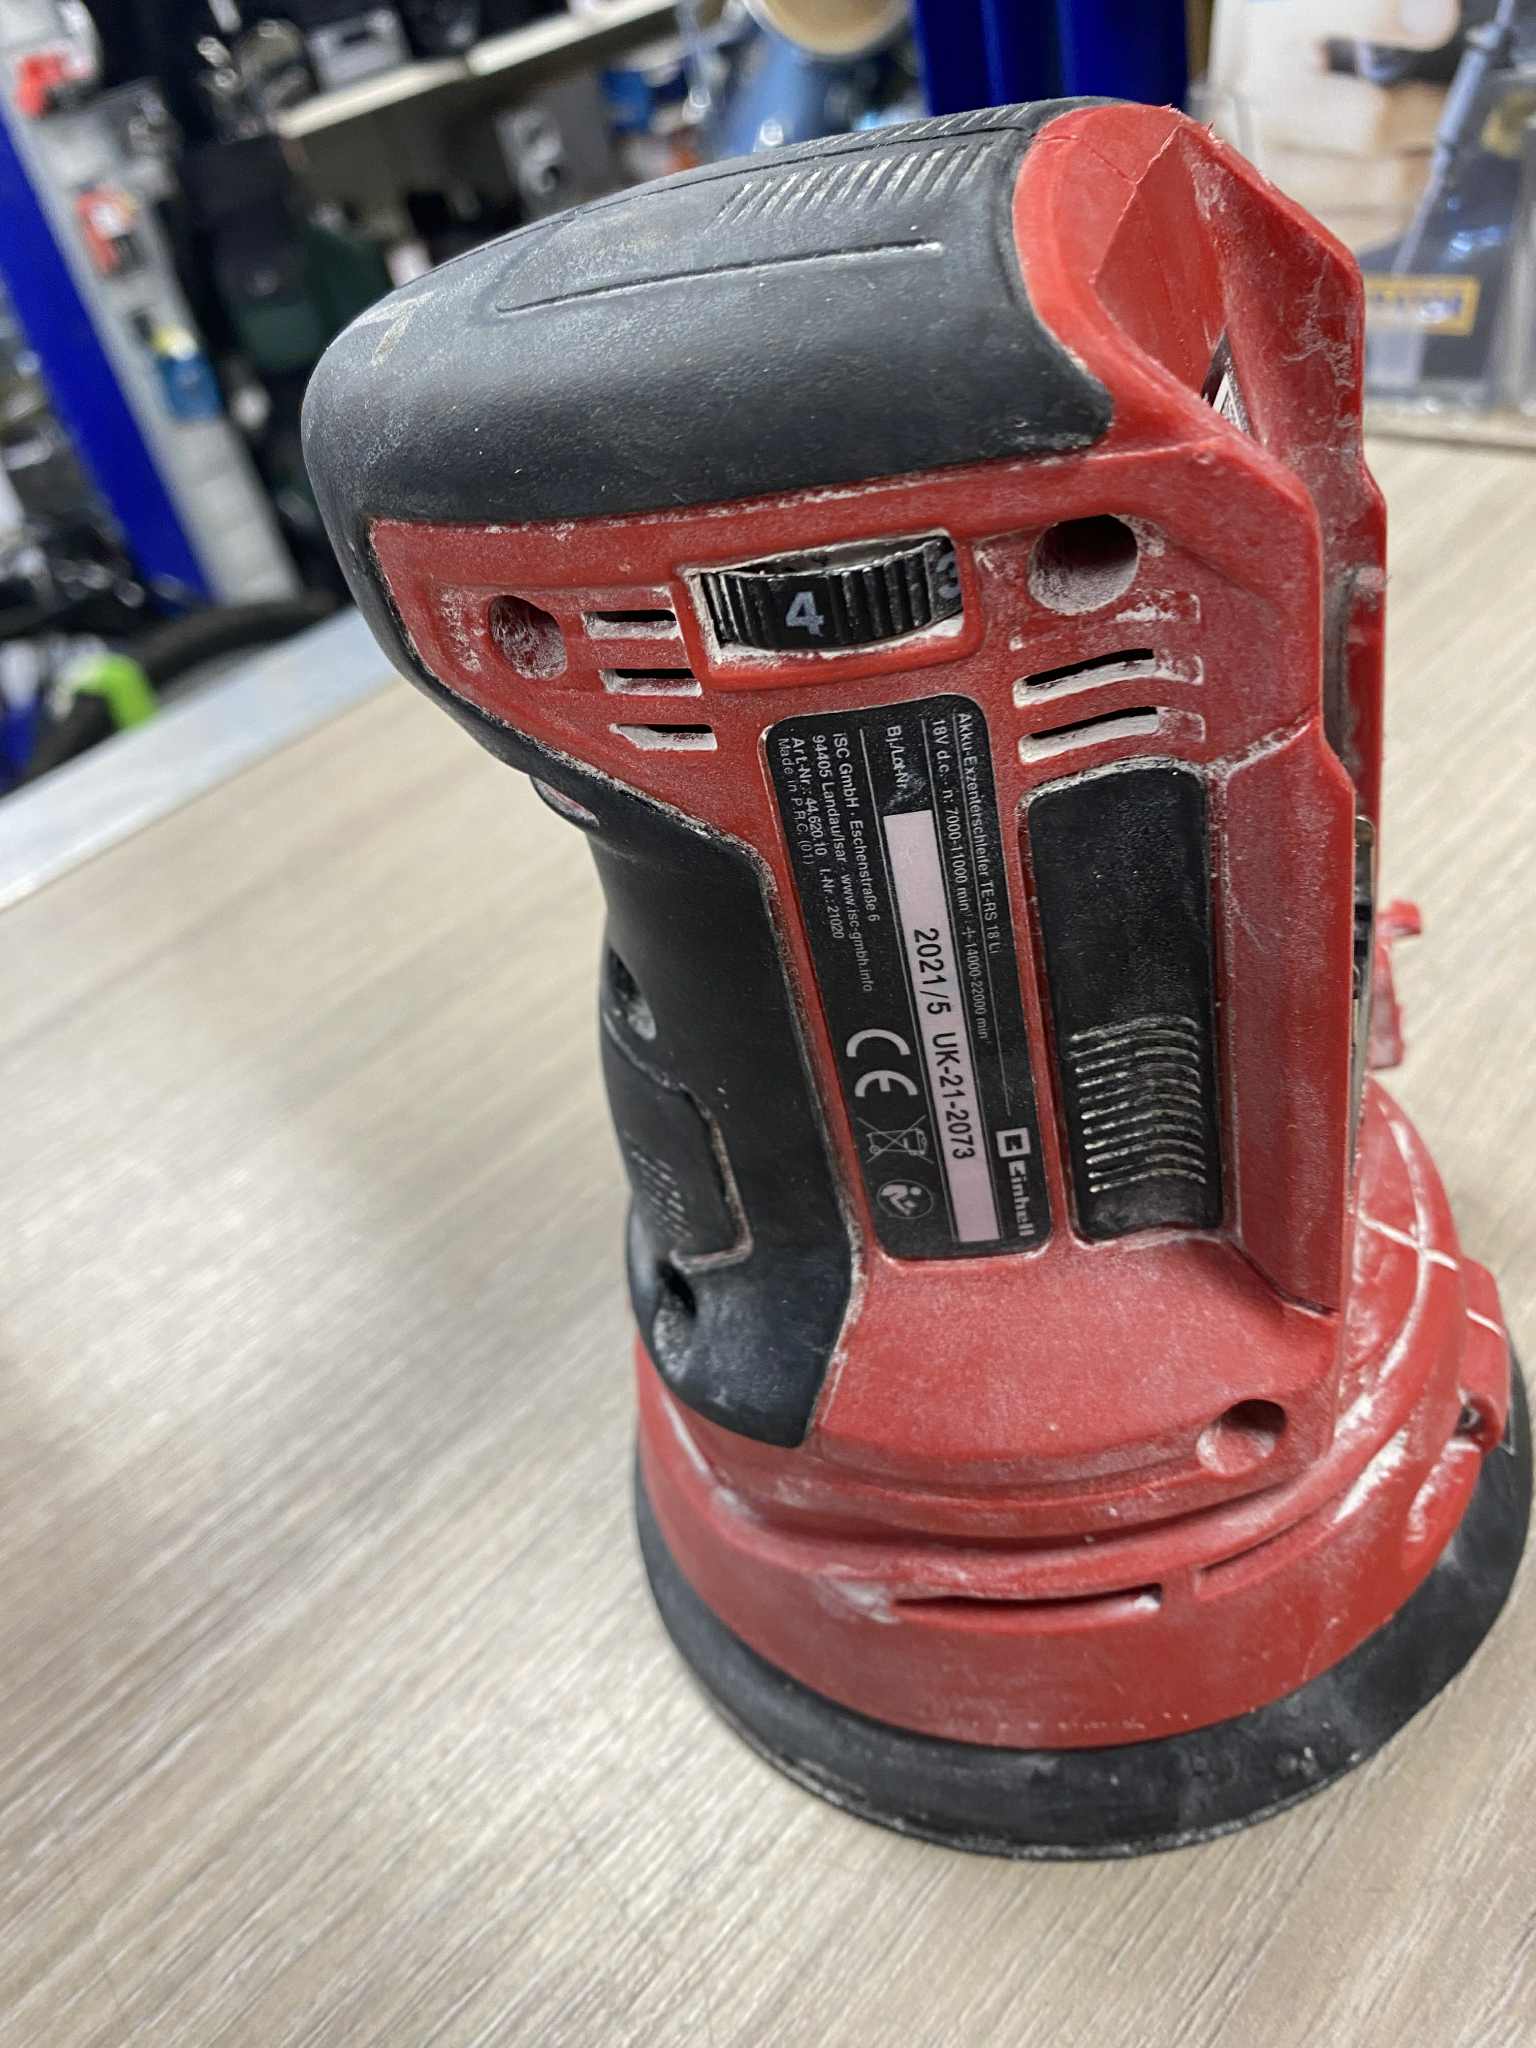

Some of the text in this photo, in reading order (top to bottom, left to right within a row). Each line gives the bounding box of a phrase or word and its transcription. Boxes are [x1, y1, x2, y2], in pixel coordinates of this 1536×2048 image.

[784, 591, 825, 637] 4
[776, 737, 796, 774] Made
[786, 779, 800, 792] in
[797, 839, 815, 865] (01)
[803, 796, 827, 856] 44.620.10
[826, 904, 844, 939] 21020
[812, 734, 874, 992] 94405 Landau/Isar www.isc-gmbh.info
[837, 762, 859, 808] GmbH
[848, 819, 878, 911] Eschenstraße
[867, 913, 880, 921] 6
[931, 719, 947, 745] 18V
[943, 806, 968, 883] 7000-11000
[964, 942, 987, 1014] 14000-22000
[979, 879, 998, 920] TE-RS
[986, 924, 999, 938] 18
[909, 926, 975, 1160] 2021/5 UK-21-2073
[1007, 1159, 1035, 1236] Einhell
